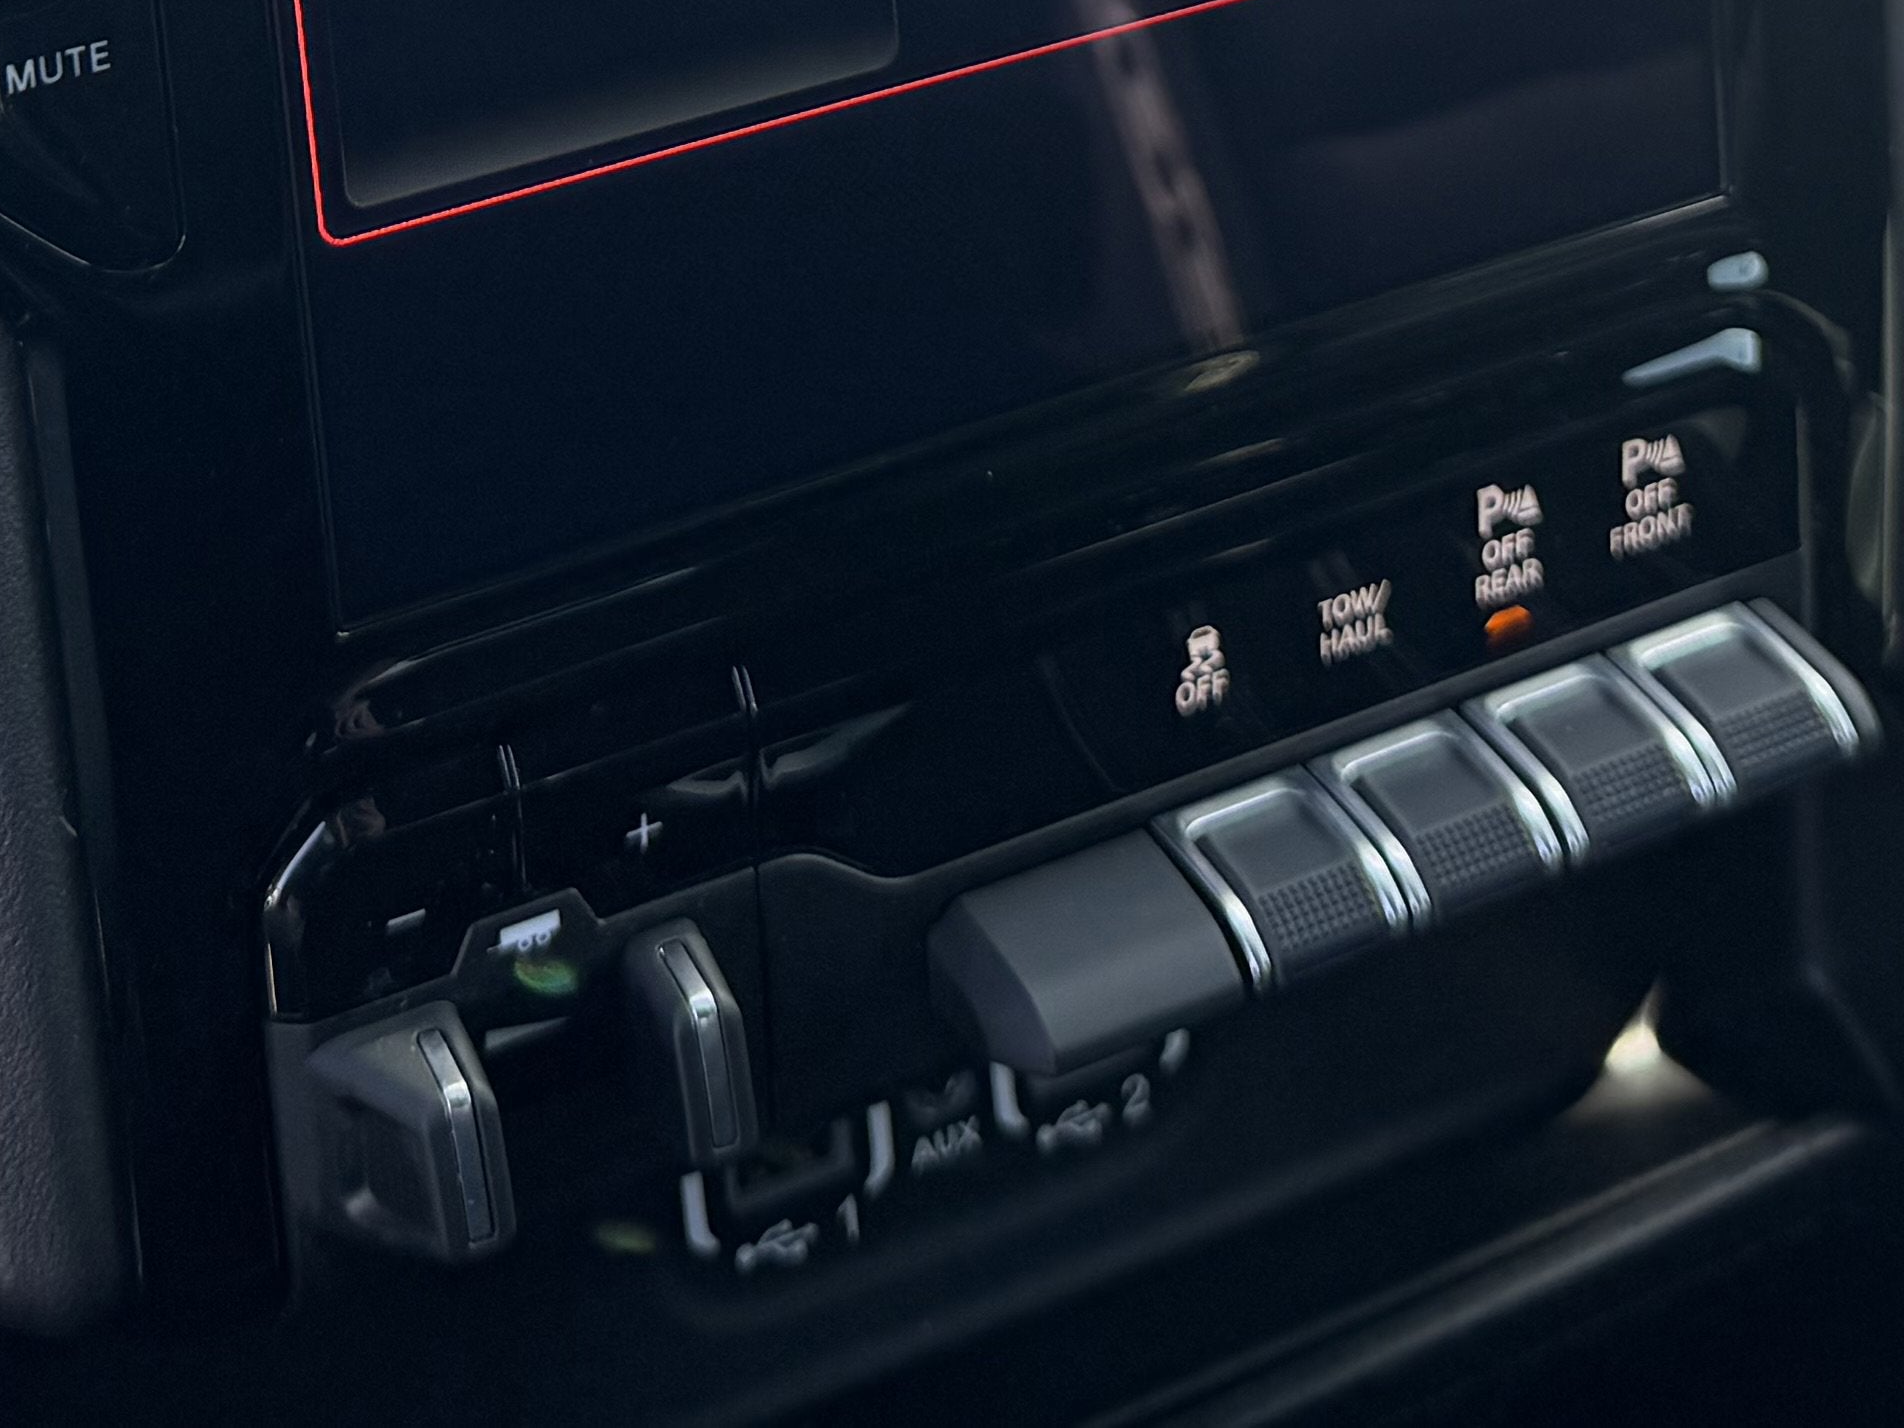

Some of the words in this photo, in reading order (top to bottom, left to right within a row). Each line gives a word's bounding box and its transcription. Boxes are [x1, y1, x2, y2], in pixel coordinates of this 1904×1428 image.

[5, 40, 111, 95] MUTE
[1625, 478, 1679, 522] OFF
[1482, 528, 1534, 570] OFF
[1610, 502, 1694, 561] FRONT
[1318, 578, 1392, 633] TOW/
[1475, 558, 1545, 610] REAR
[1320, 613, 1394, 666] HAUL
[1175, 667, 1230, 717] OFF
[1121, 1073, 1151, 1125] 2
[912, 1115, 981, 1176] AUX
